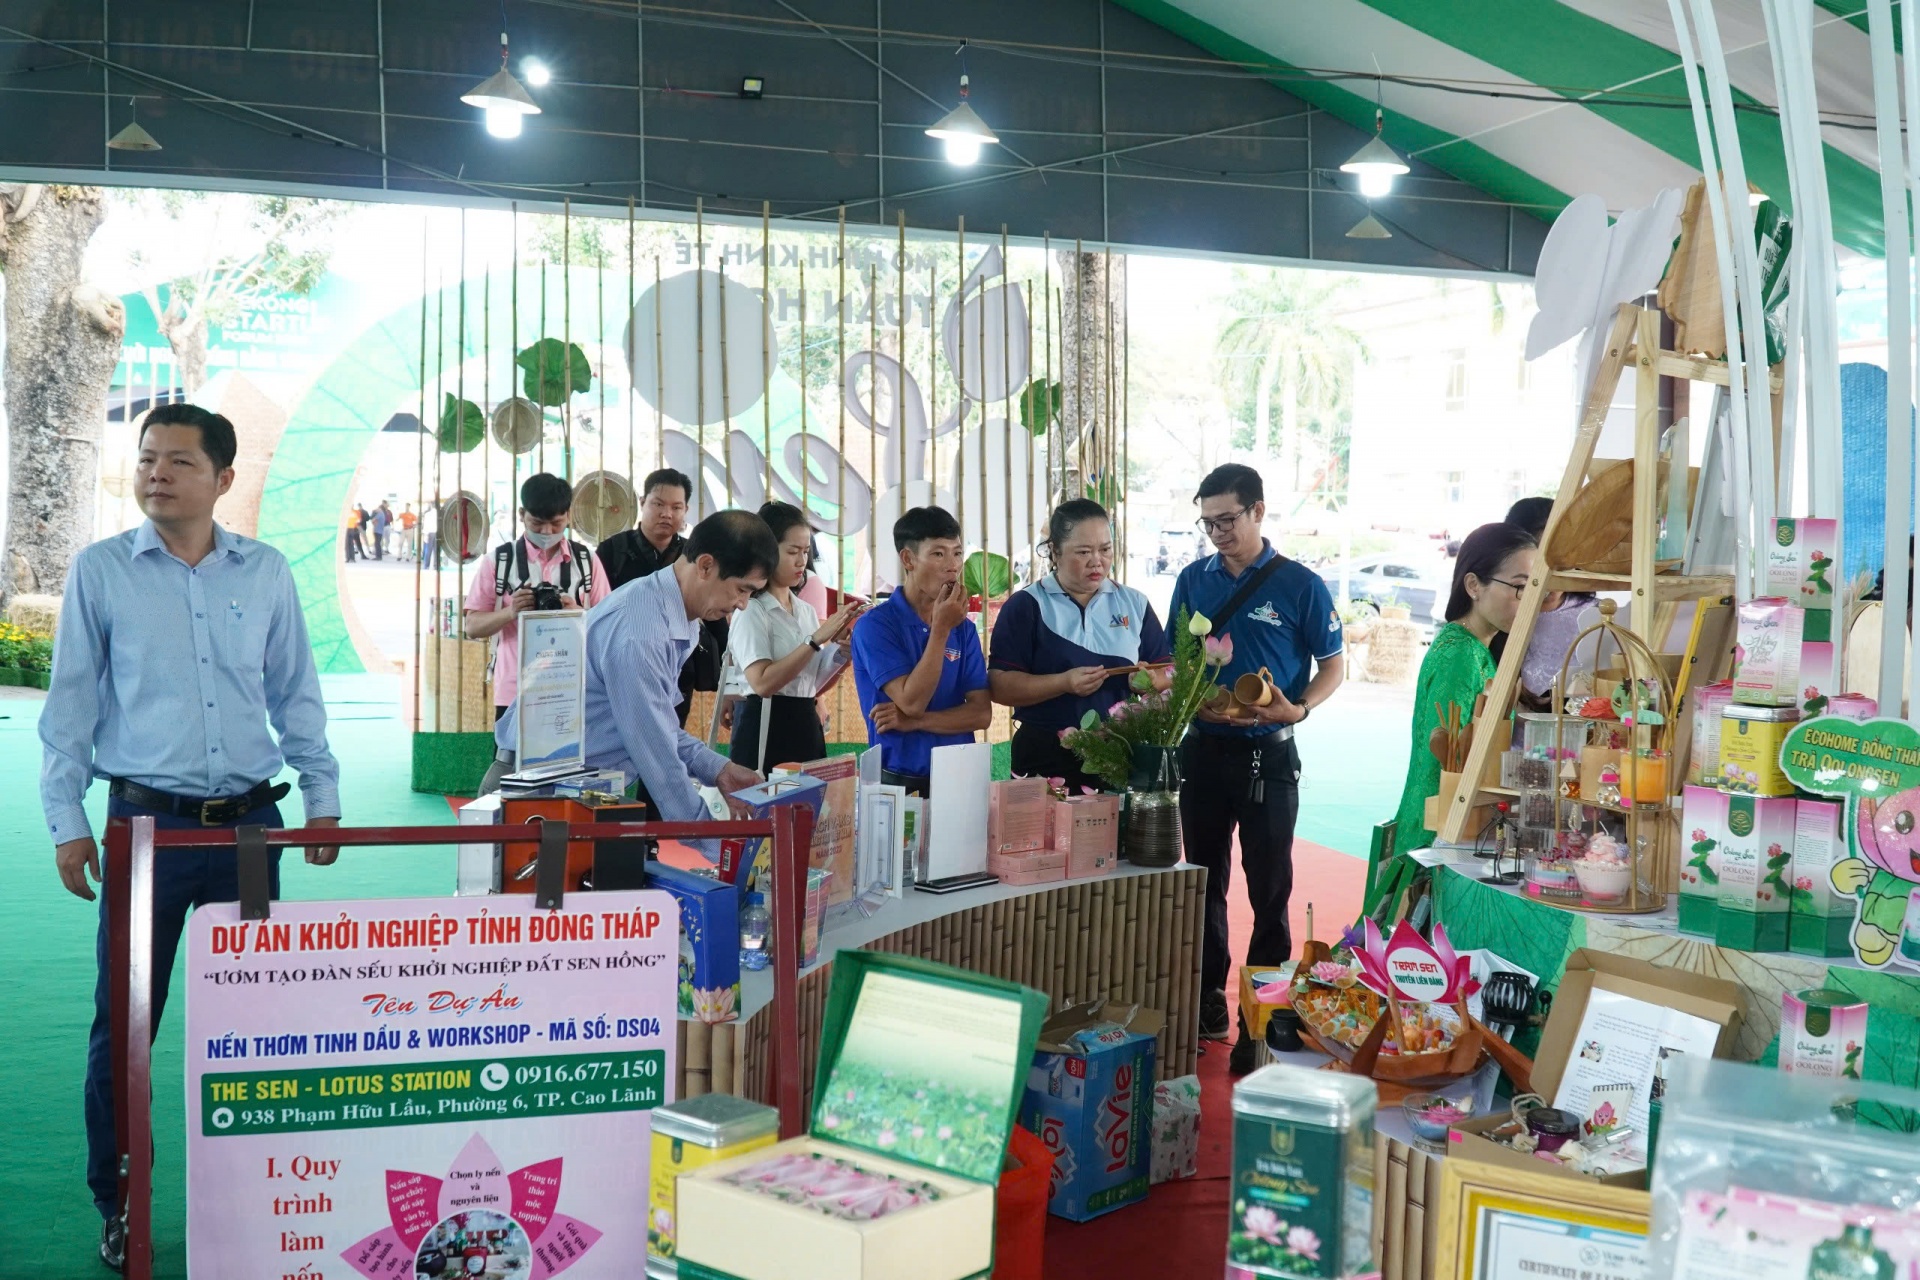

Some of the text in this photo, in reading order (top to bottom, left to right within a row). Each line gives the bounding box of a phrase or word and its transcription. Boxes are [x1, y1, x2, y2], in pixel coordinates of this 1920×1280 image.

[1804, 728, 1860, 753] ECOHOME
[1861, 735, 1893, 761] ĐỒNG
[1791, 750, 1817, 770] TRÀ
[212, 923, 249, 960] DỰ
[254, 918, 291, 953] ÁN
[300, 912, 359, 951] KHỞI
[367, 912, 458, 952] NGHIỆP
[466, 908, 521, 945] TỈNH
[601, 906, 660, 939] THÁP
[265, 969, 306, 986] TẠO
[312, 964, 351, 981] ĐÀN
[357, 960, 392, 979] SẾU
[398, 960, 446, 978] KHỞI
[452, 957, 522, 976] NGHIỆP
[527, 953, 563, 972] ĐẤT
[567, 957, 600, 971] SEN
[362, 993, 417, 1017] Tên
[478, 982, 522, 1013] Án
[207, 1031, 247, 1059] NẾN
[253, 1034, 307, 1057] THƠM
[314, 1033, 357, 1054] TINH
[407, 1029, 421, 1049] &
[428, 1023, 531, 1048] WORKSHOP
[549, 1018, 577, 1042] MÃ
[583, 1013, 611, 1040] SỐ:
[616, 1017, 661, 1038] DS04
[210, 1081, 249, 1102] THE
[255, 1079, 298, 1100] SEN
[320, 1075, 384, 1097] LOTUS
[390, 1069, 471, 1093] STATION
[515, 1059, 658, 1085] 0916.677.150
[241, 1108, 275, 1126] 938
[281, 1108, 336, 1126] Phạm
[342, 1103, 383, 1121] Hữu
[438, 1096, 508, 1114] Phường
[512, 1095, 529, 1111] 6,
[533, 1092, 565, 1107] TP.
[570, 1090, 606, 1106] Cao
[611, 1086, 656, 1103] Lãnh
[266, 1155, 341, 1181] I. Quy
[450, 1167, 501, 1181] Chọn ly nến
[523, 1171, 546, 1186] Trang
[470, 1183, 480, 1191] và
[273, 1193, 332, 1215] trình
[450, 1196, 481, 1206] nguyên
[519, 1210, 547, 1224] topping
[280, 1231, 324, 1252] làm
